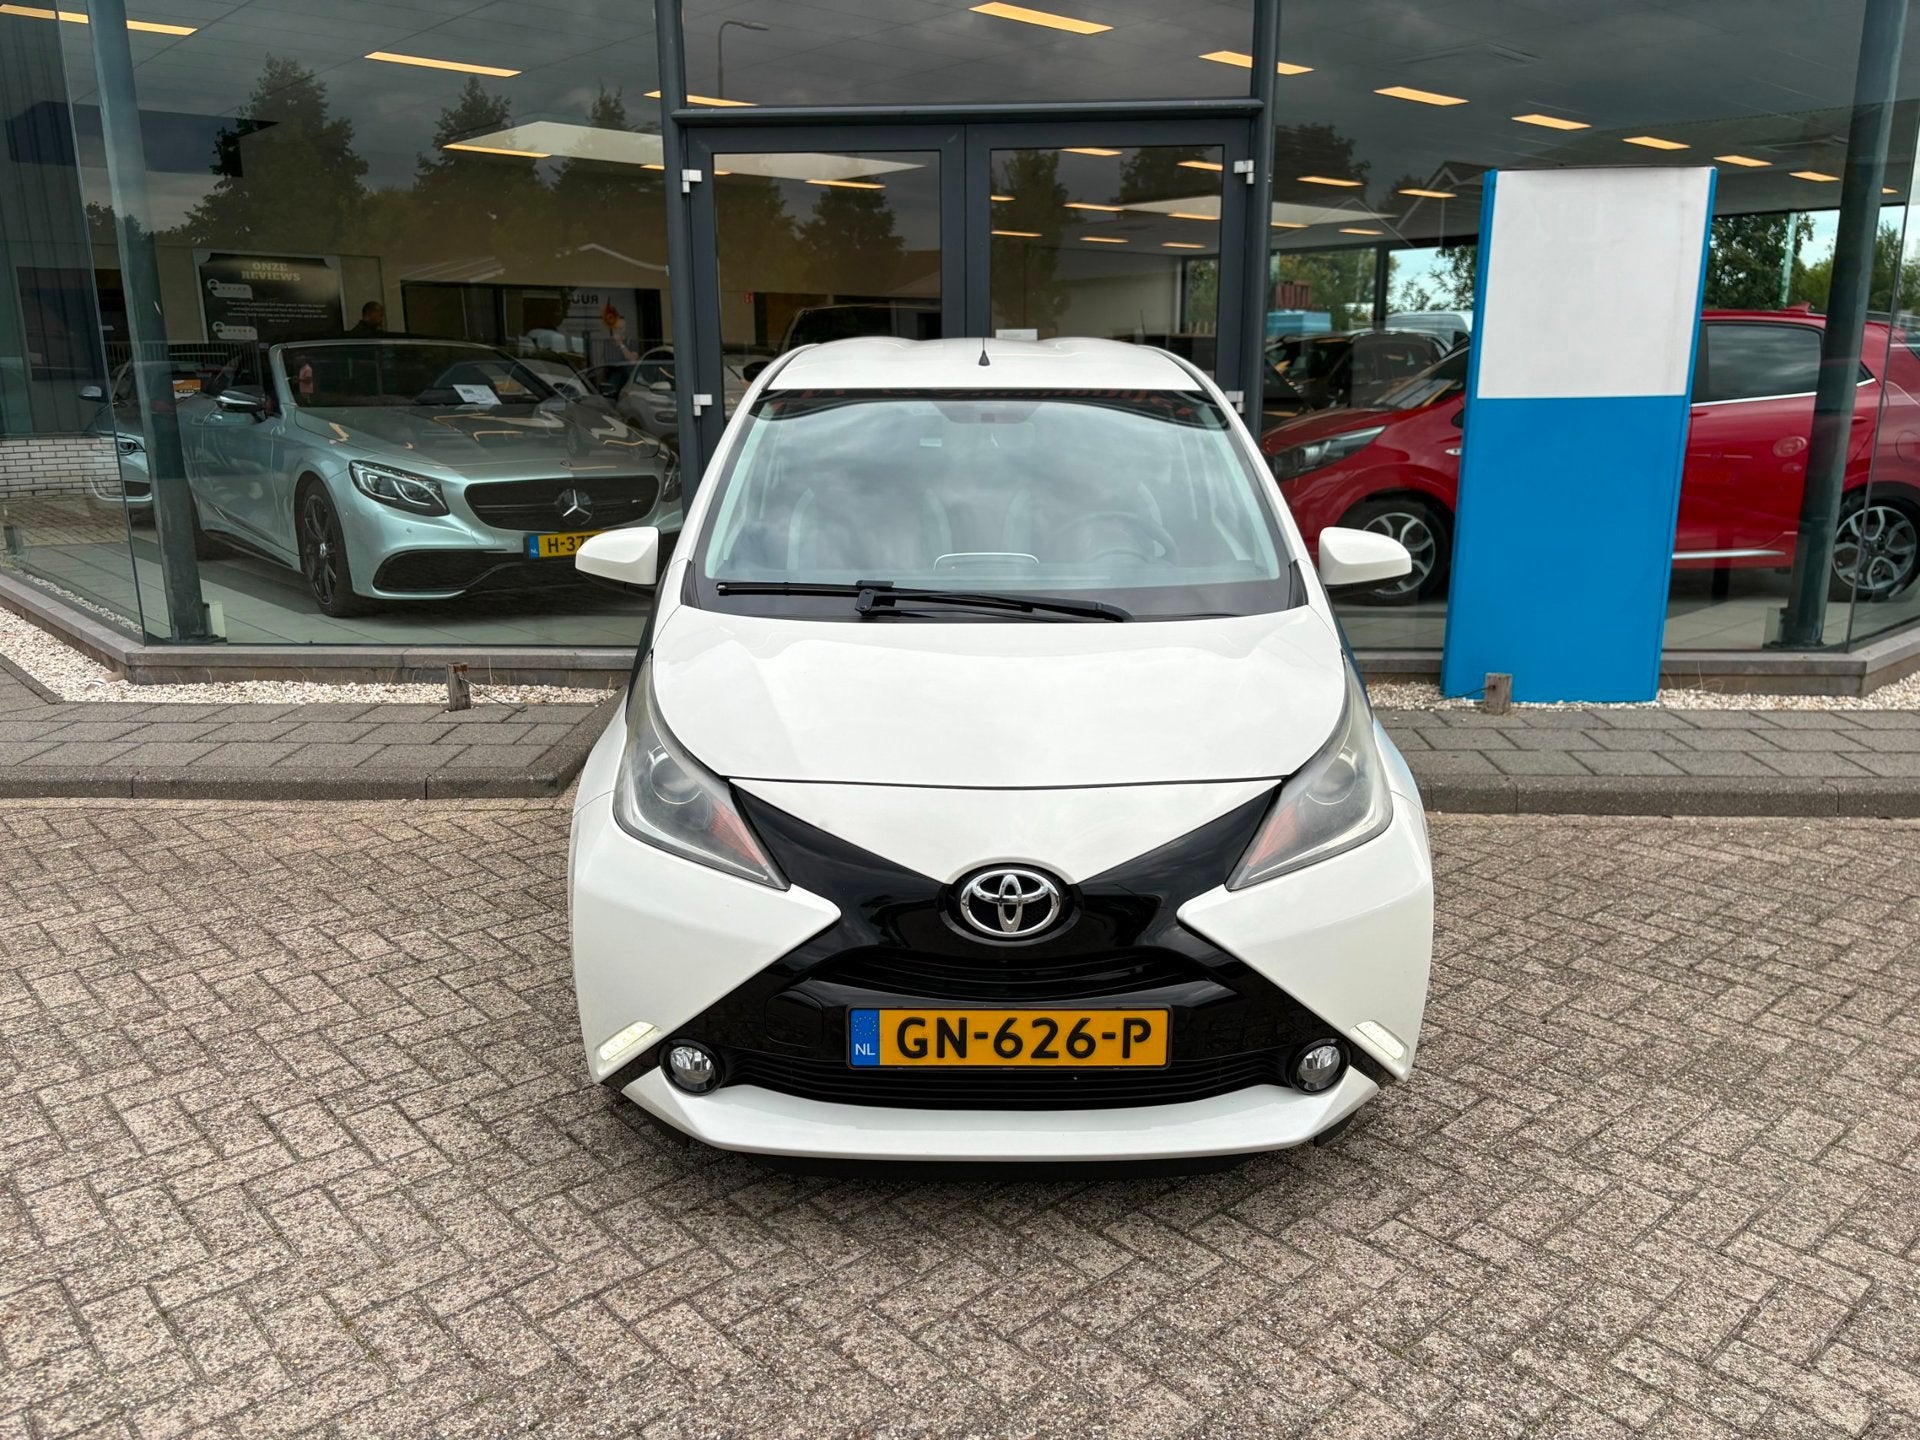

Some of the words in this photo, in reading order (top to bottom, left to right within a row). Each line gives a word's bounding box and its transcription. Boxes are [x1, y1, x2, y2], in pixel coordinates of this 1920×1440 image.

[252, 262, 288, 272] ONZE
[241, 271, 301, 281] REVIEWS
[547, 535, 594, 553] H-37
[855, 1043, 875, 1056] NL
[896, 1016, 1152, 1059] GN-626-P
